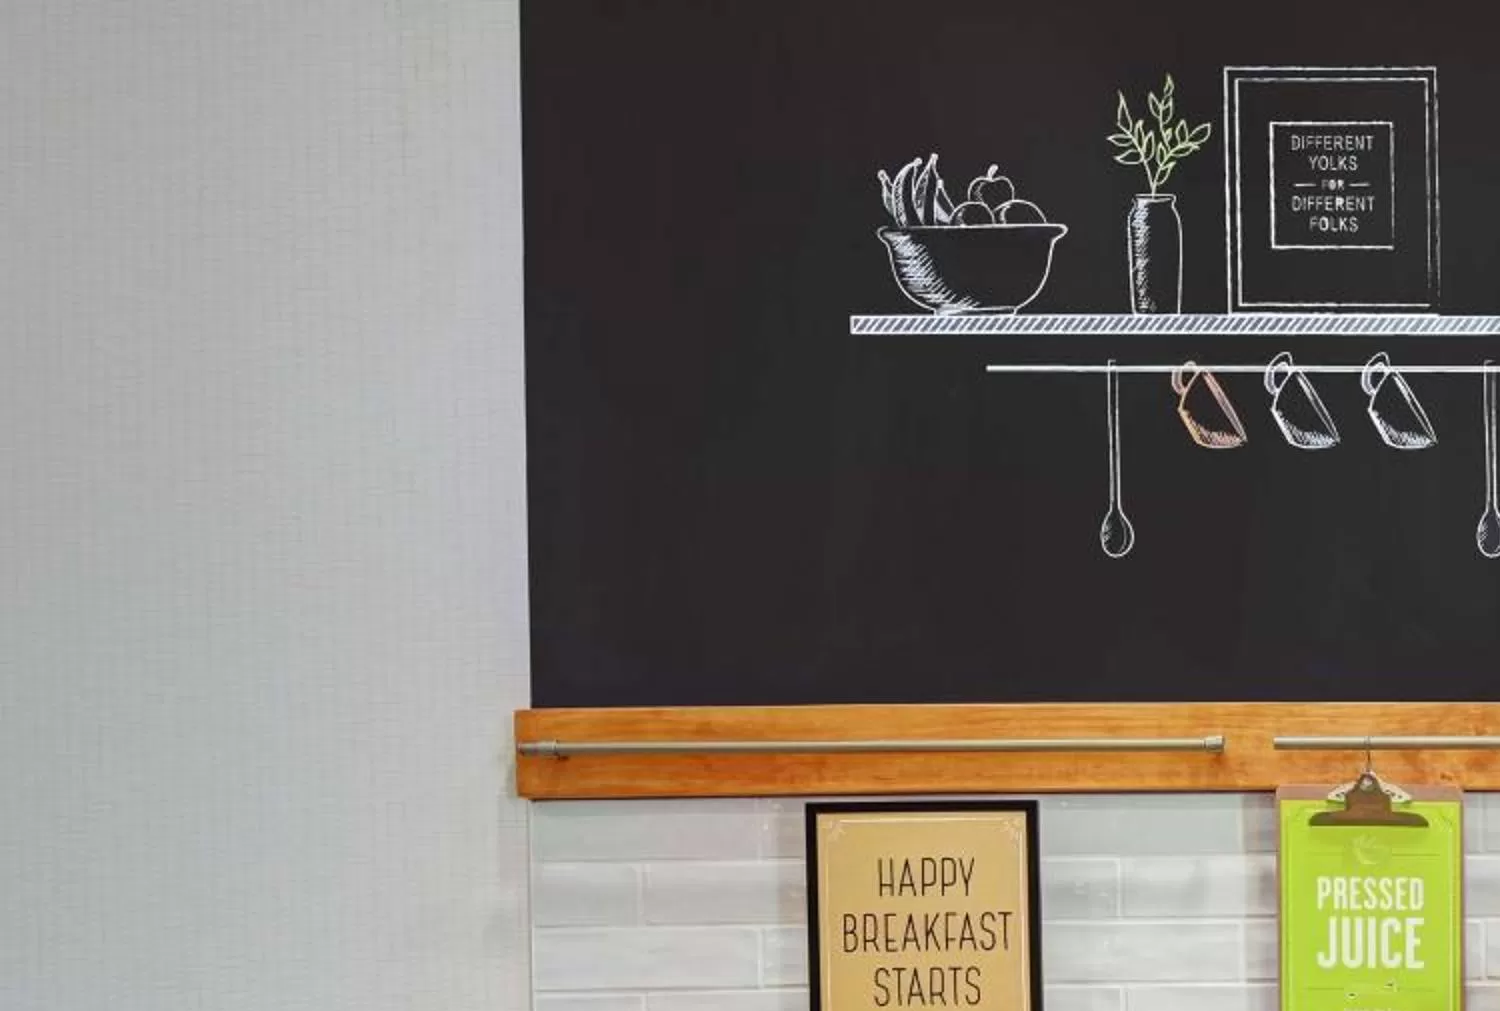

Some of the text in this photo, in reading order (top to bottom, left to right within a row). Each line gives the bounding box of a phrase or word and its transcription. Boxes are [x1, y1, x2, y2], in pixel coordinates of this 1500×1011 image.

[1291, 135, 1374, 151] DIFFERENT
[1308, 155, 1359, 171] YOLKS
[1321, 179, 1345, 191] FOR
[1291, 195, 1375, 212] DIFFERENT
[1309, 216, 1359, 233] FOLKS
[877, 856, 976, 897] HAPPY
[1316, 876, 1425, 911] PRESSED
[842, 911, 1013, 953] BREAKFAST
[1316, 915, 1425, 969] JUICE
[873, 966, 982, 1007] STARTS
